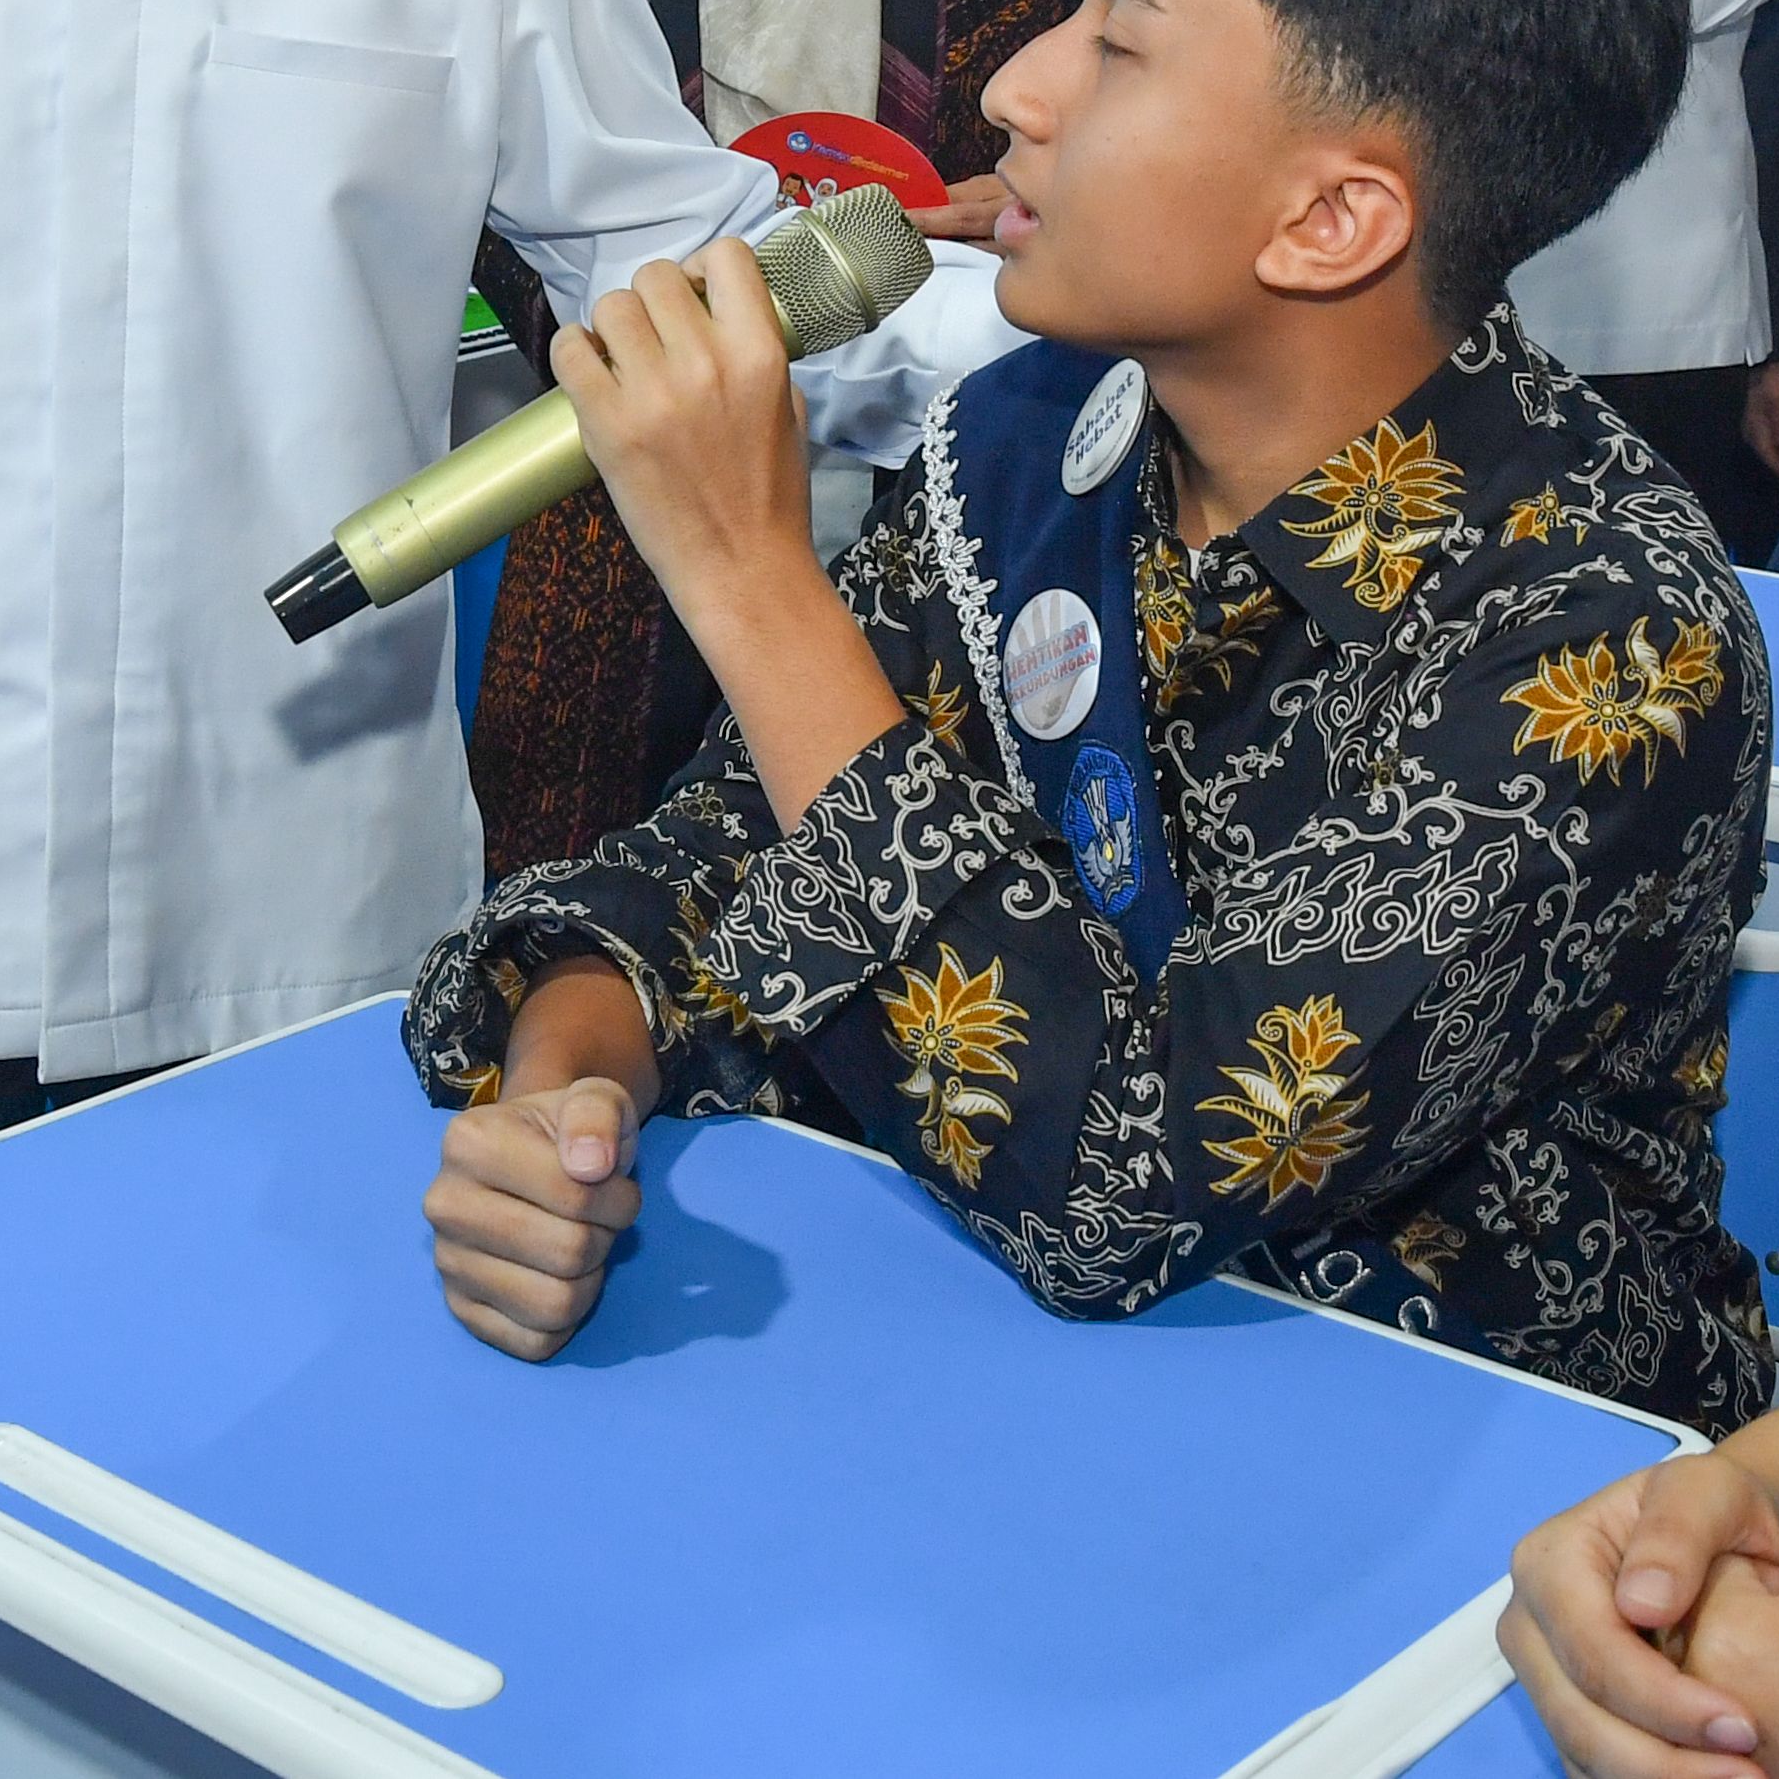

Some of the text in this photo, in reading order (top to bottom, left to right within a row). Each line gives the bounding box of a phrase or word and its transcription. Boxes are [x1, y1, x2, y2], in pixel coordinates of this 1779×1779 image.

[1067, 371, 1134, 459] Sahabat
[1075, 403, 1123, 464] Hebat
[1008, 624, 1088, 681] HENTIKAN
